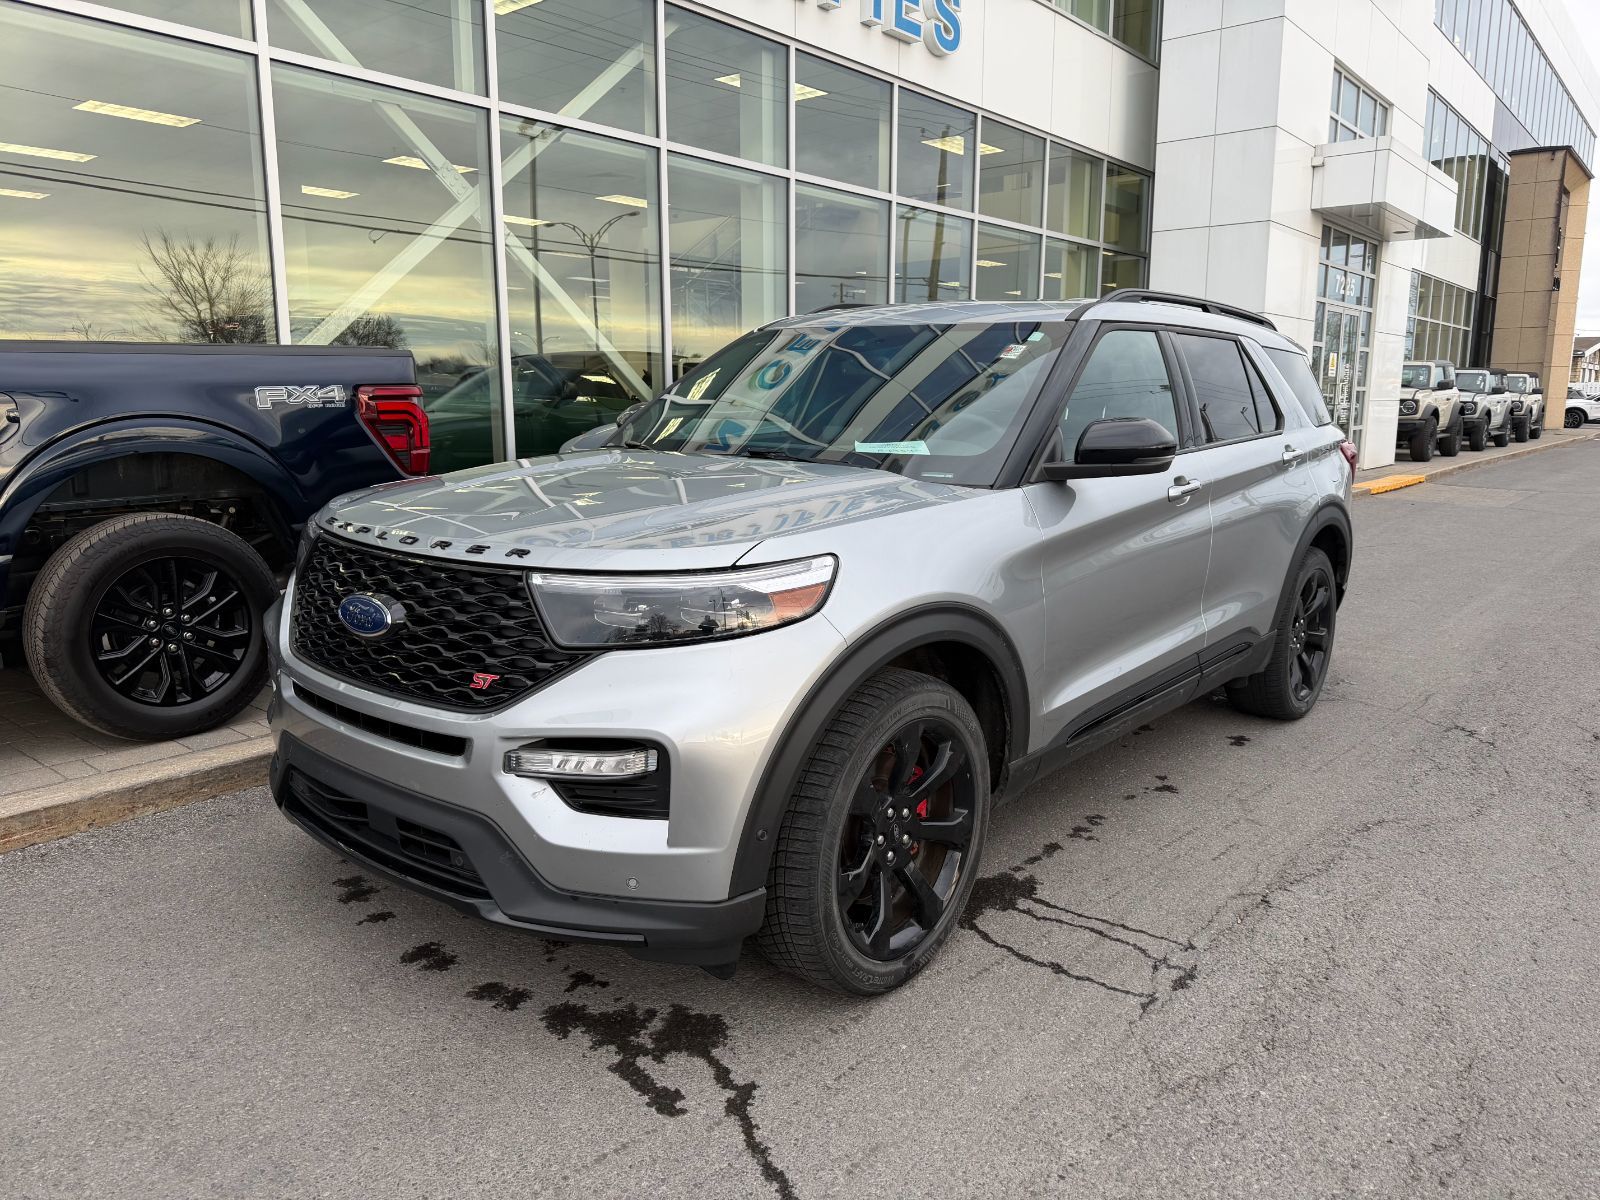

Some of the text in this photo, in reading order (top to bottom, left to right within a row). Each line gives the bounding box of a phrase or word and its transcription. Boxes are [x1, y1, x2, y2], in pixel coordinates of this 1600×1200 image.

[1335, 274, 1356, 297] 7225
[254, 385, 347, 410] FX4
[325, 516, 532, 559] EXPLORER
[469, 673, 500, 690] ST
